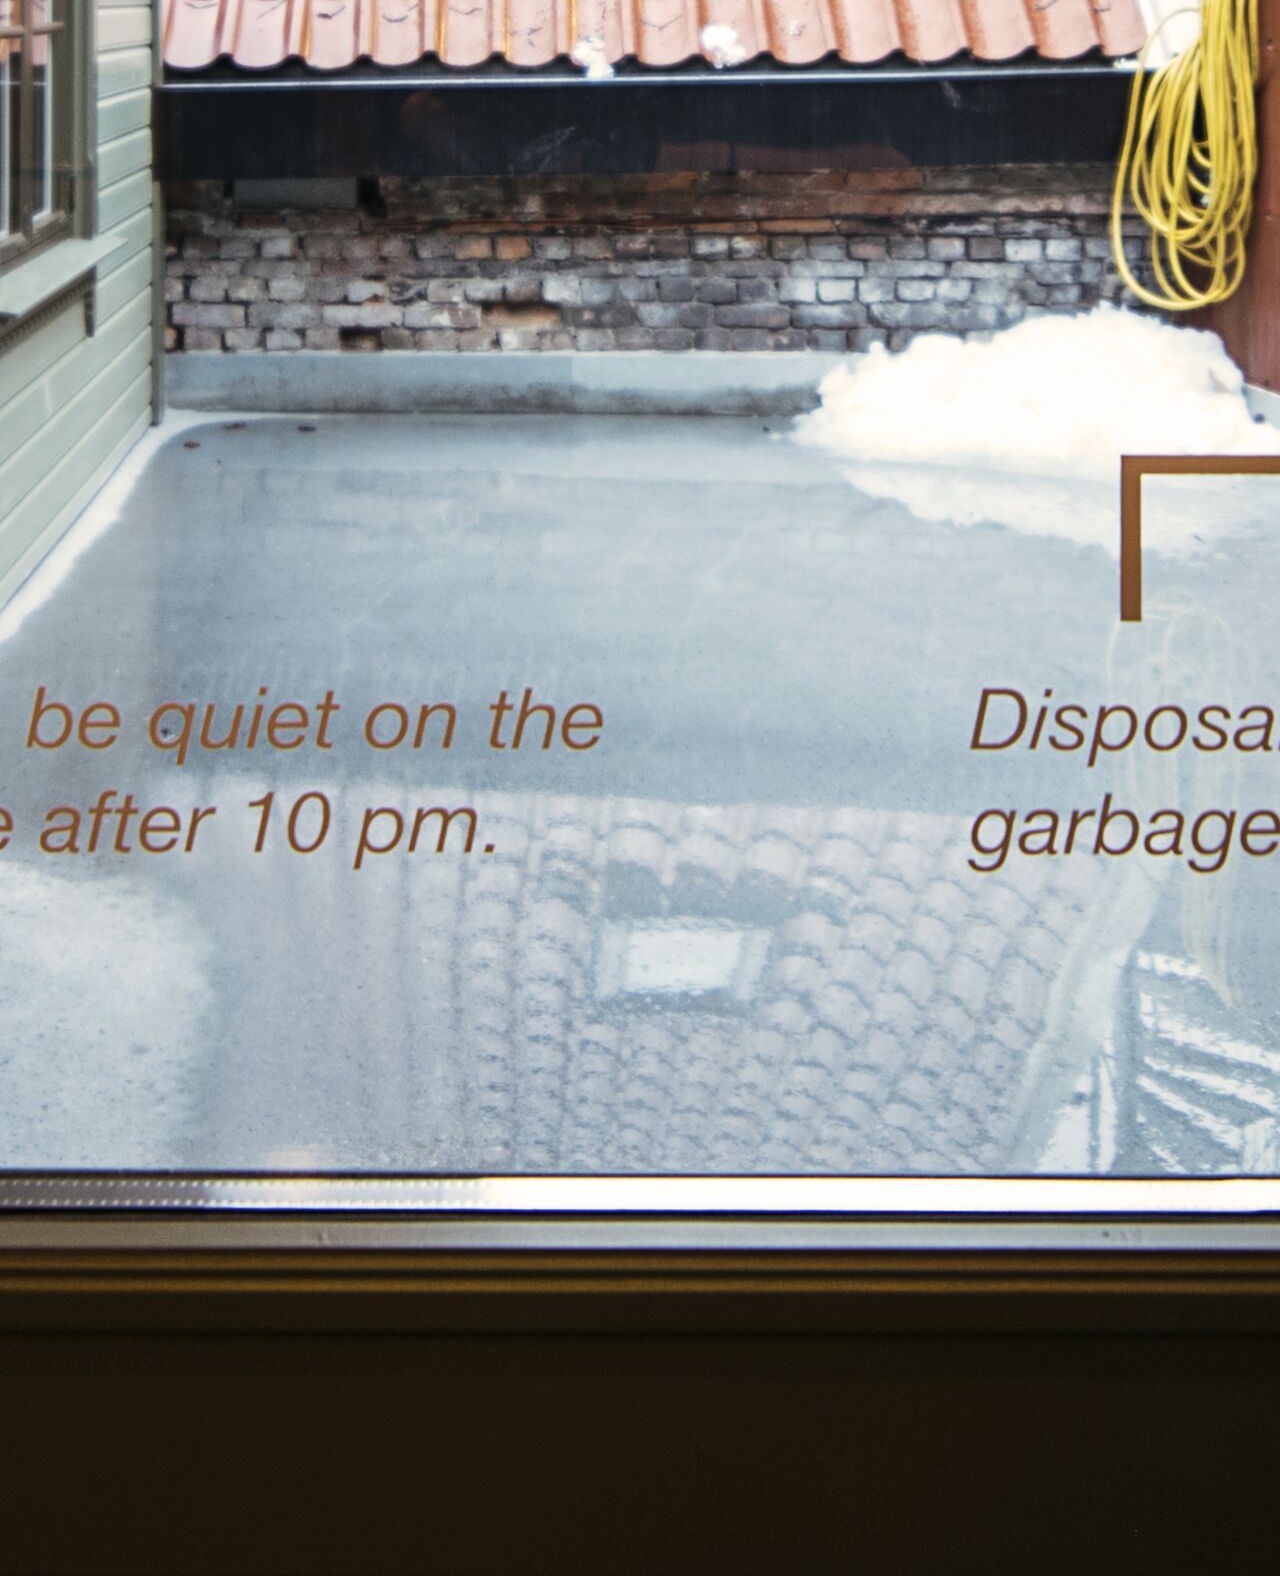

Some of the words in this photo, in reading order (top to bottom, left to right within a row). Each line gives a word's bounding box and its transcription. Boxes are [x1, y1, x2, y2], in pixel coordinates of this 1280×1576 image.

[26, 686, 121, 750] be
[147, 686, 340, 765] quiet
[362, 699, 455, 750] on
[488, 688, 604, 750] the
[38, 789, 214, 853] after
[246, 791, 332, 854] 10
[351, 803, 498, 869] pm.
